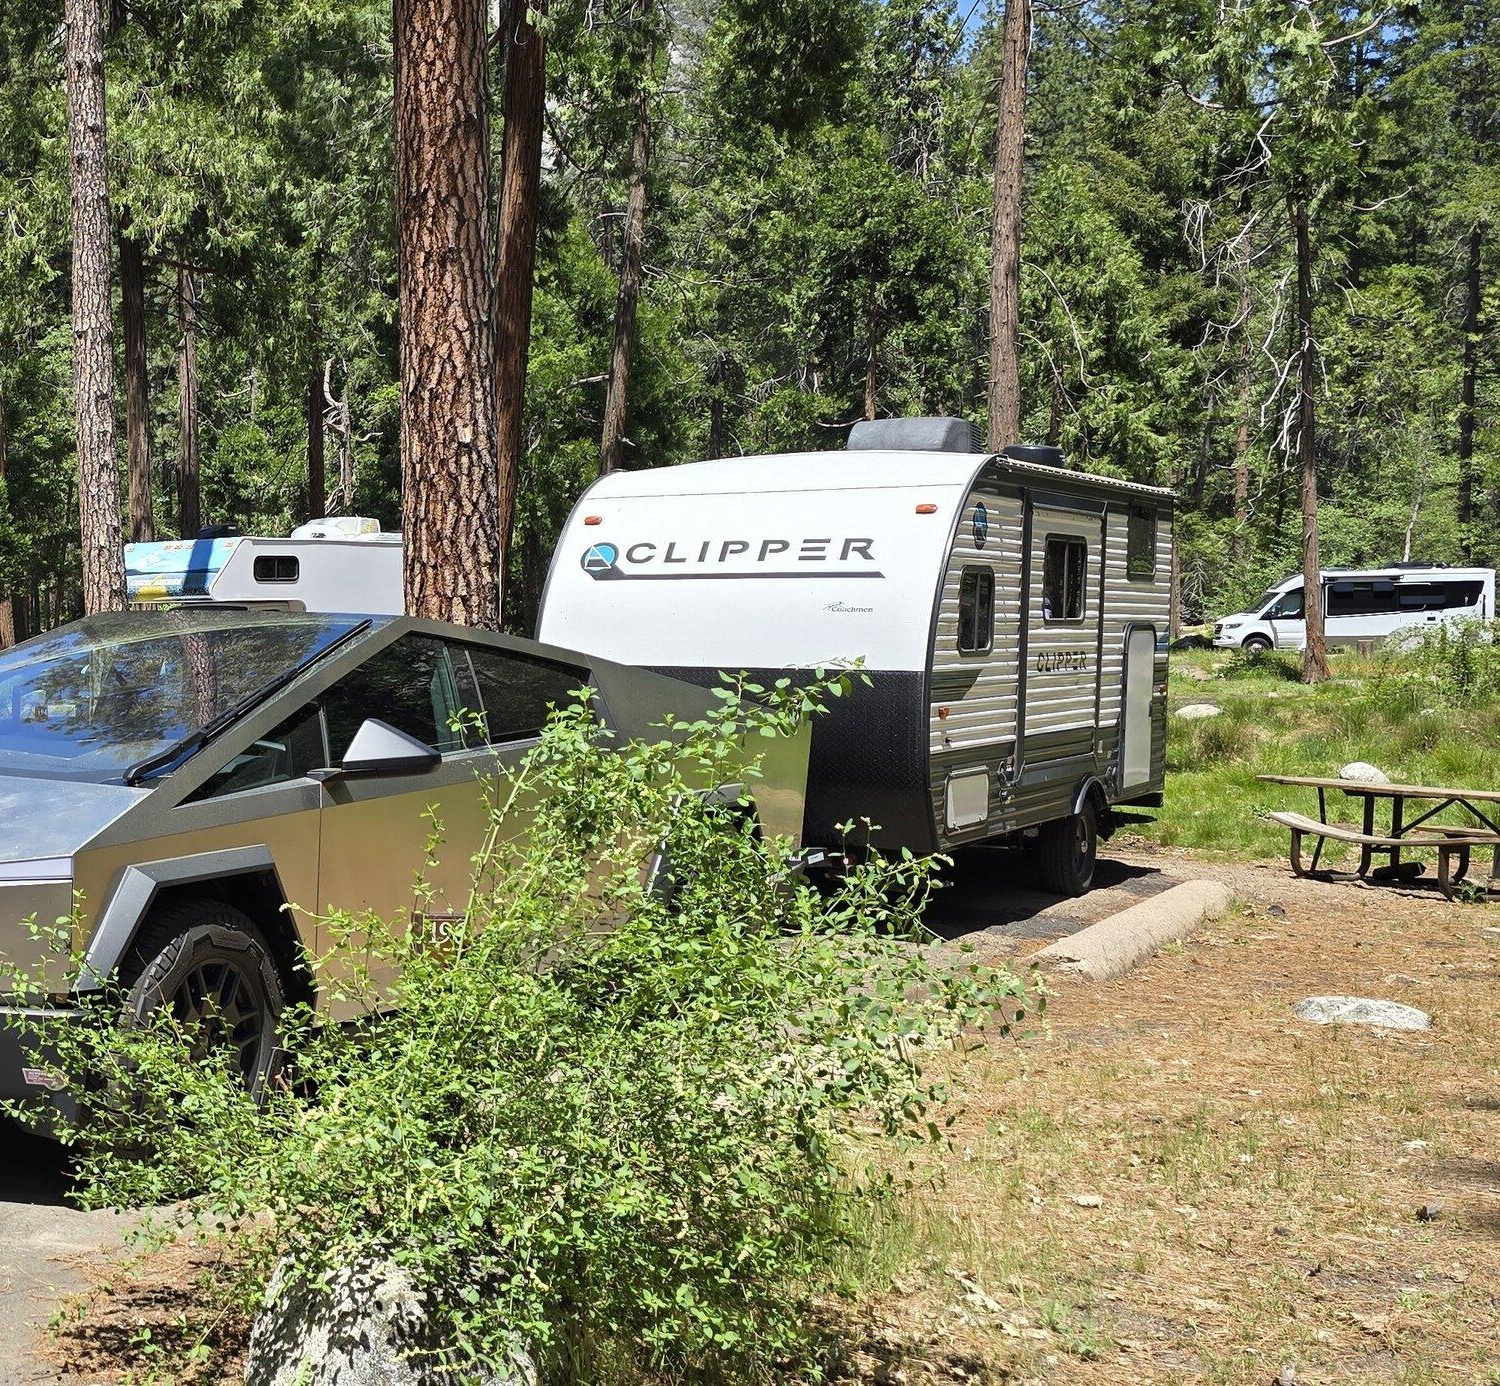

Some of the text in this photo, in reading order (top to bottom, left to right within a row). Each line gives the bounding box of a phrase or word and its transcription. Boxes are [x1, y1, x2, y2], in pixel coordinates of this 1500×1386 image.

[625, 537, 876, 564] CLIPPER
[830, 604, 874, 613] Coachmen
[1037, 651, 1087, 672] CLIPPER
